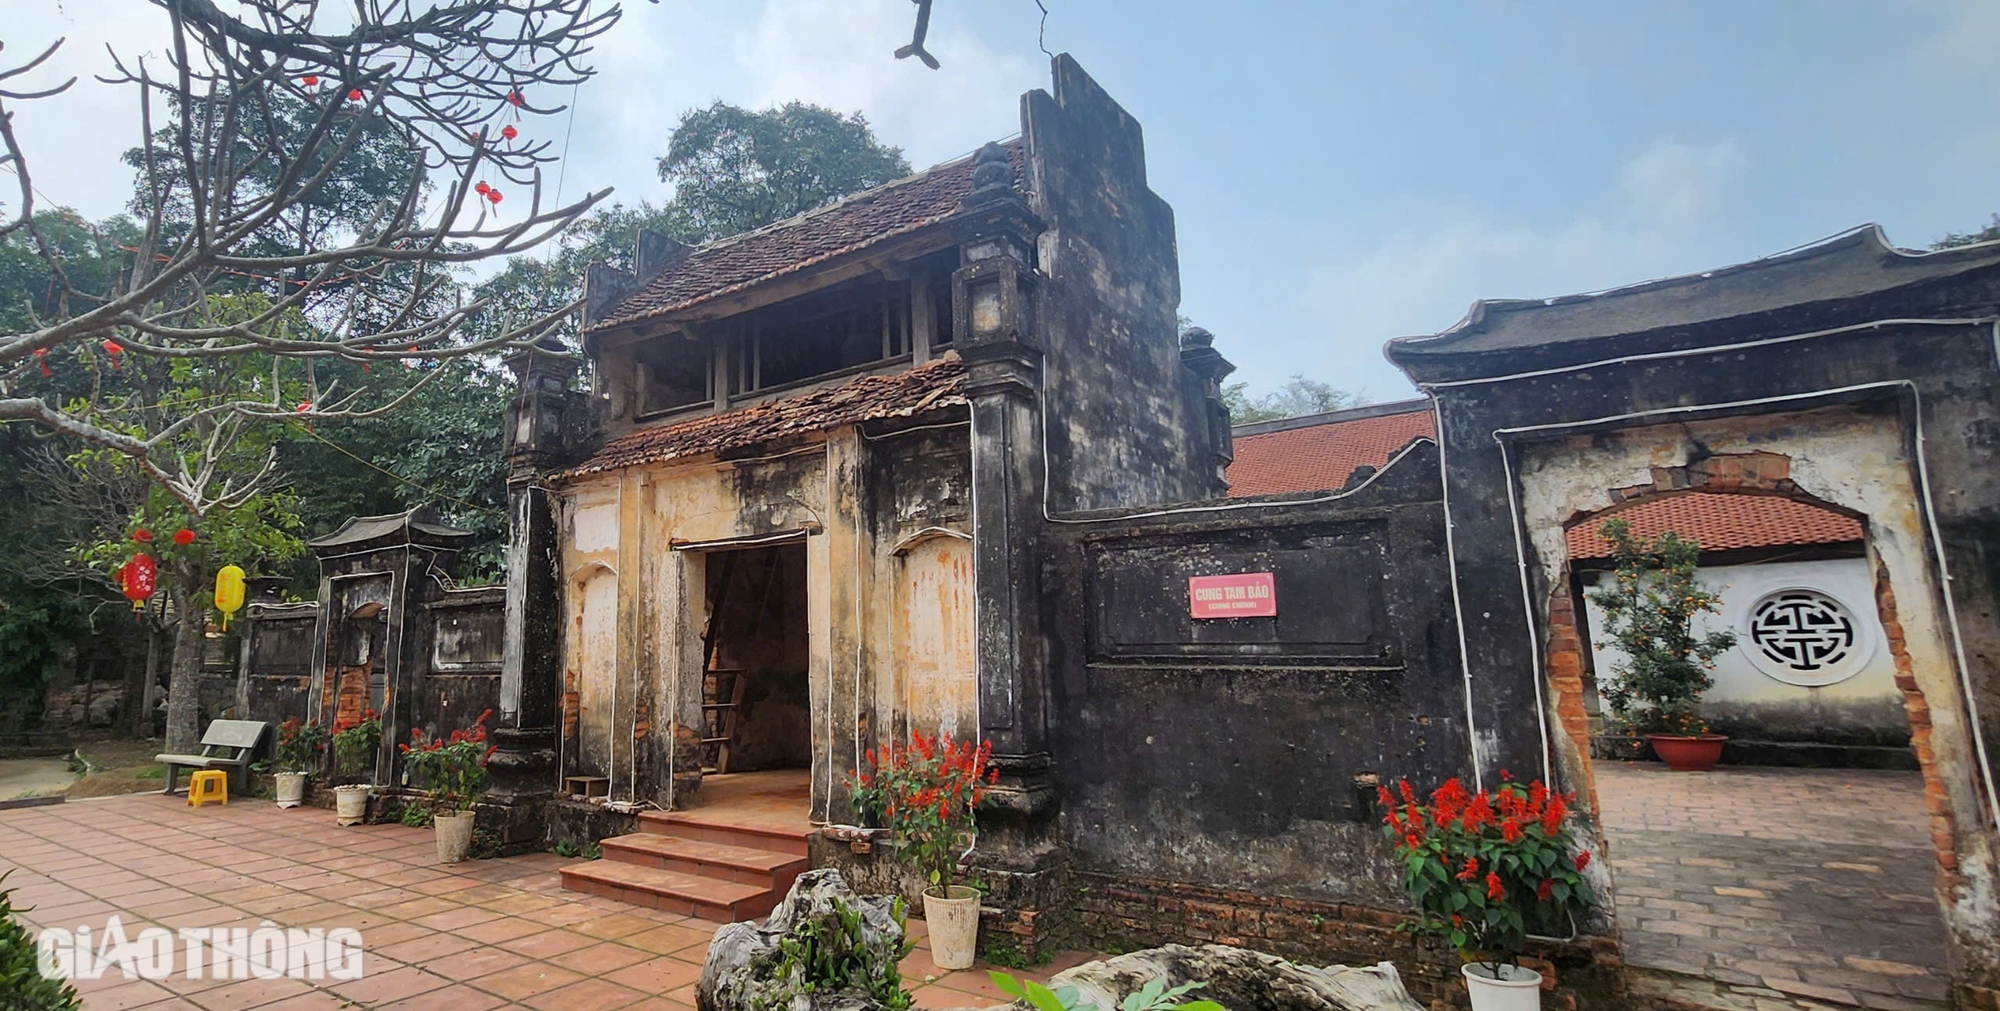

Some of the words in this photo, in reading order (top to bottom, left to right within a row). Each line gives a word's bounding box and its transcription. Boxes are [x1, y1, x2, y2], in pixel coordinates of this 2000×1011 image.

[1196, 588, 1222, 600] CUNG
[1224, 587, 1245, 599] TAM
[1248, 581, 1268, 598] BẢO
